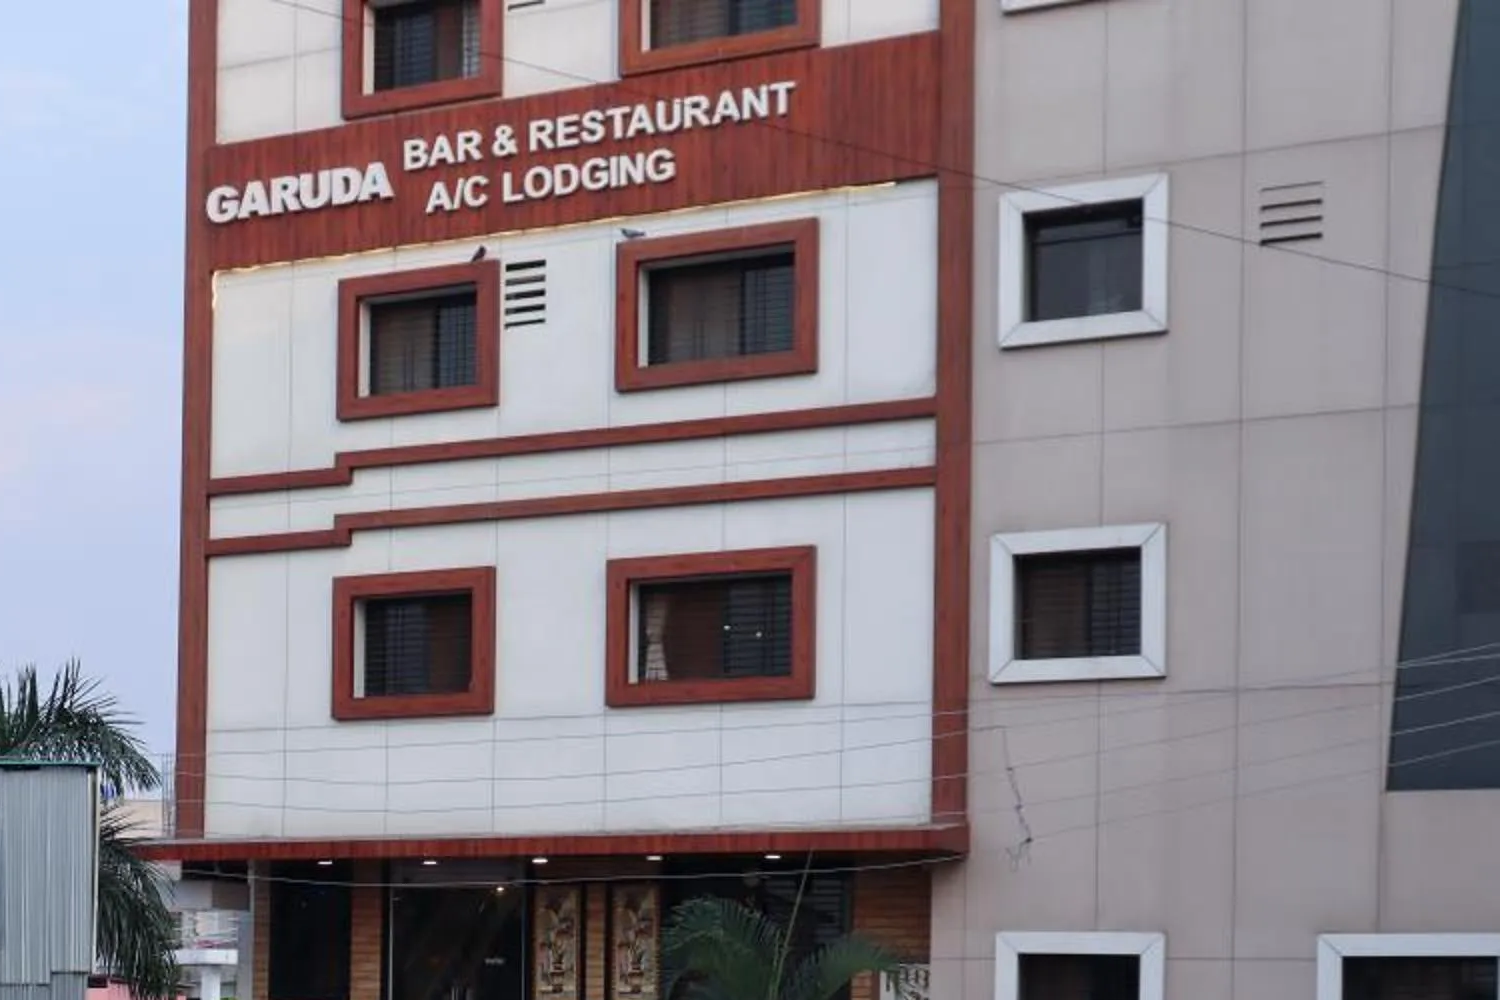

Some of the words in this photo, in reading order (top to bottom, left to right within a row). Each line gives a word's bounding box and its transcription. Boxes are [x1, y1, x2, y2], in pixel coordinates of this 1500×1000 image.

[403, 125, 483, 172] BAR
[491, 122, 517, 158] &
[528, 81, 796, 153] RESTAURANT
[206, 162, 394, 224] GARUDA
[425, 175, 488, 214] A/C
[501, 148, 676, 203] LODGING
